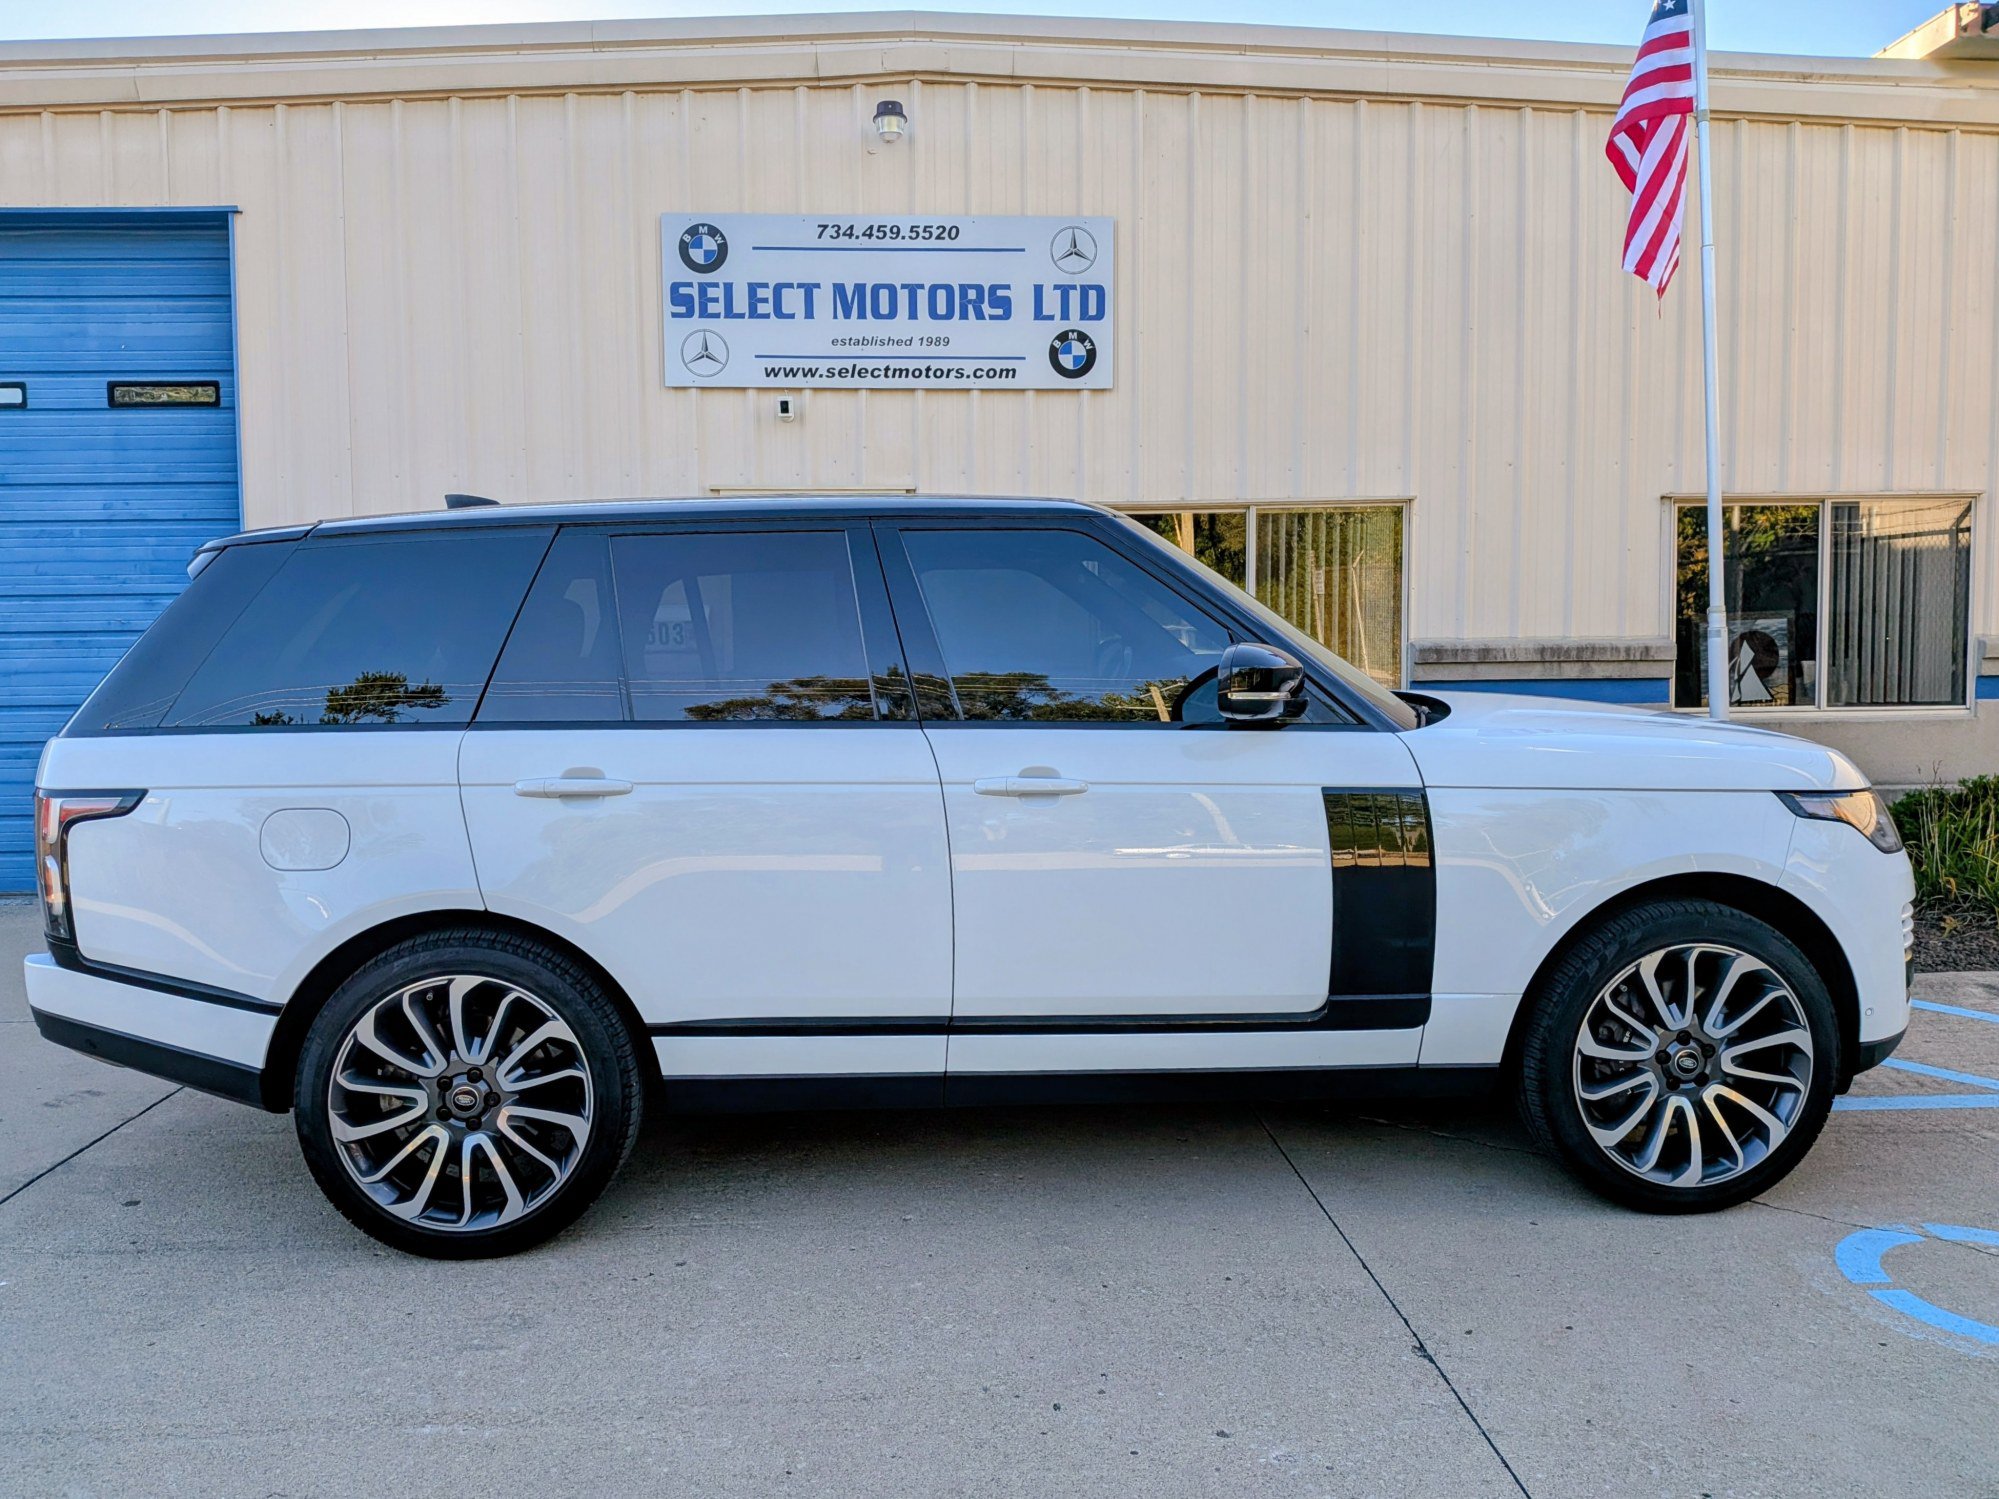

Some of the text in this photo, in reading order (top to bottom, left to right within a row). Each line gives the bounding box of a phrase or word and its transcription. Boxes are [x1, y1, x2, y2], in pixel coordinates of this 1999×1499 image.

[682, 225, 725, 244] BMW
[816, 223, 961, 242] 734.459.5520
[669, 281, 1106, 322] SELECT MOTORS LTD
[830, 335, 951, 348] established 1989
[1052, 331, 1095, 350] BMW
[763, 362, 1018, 381] www.selectmotors.com
